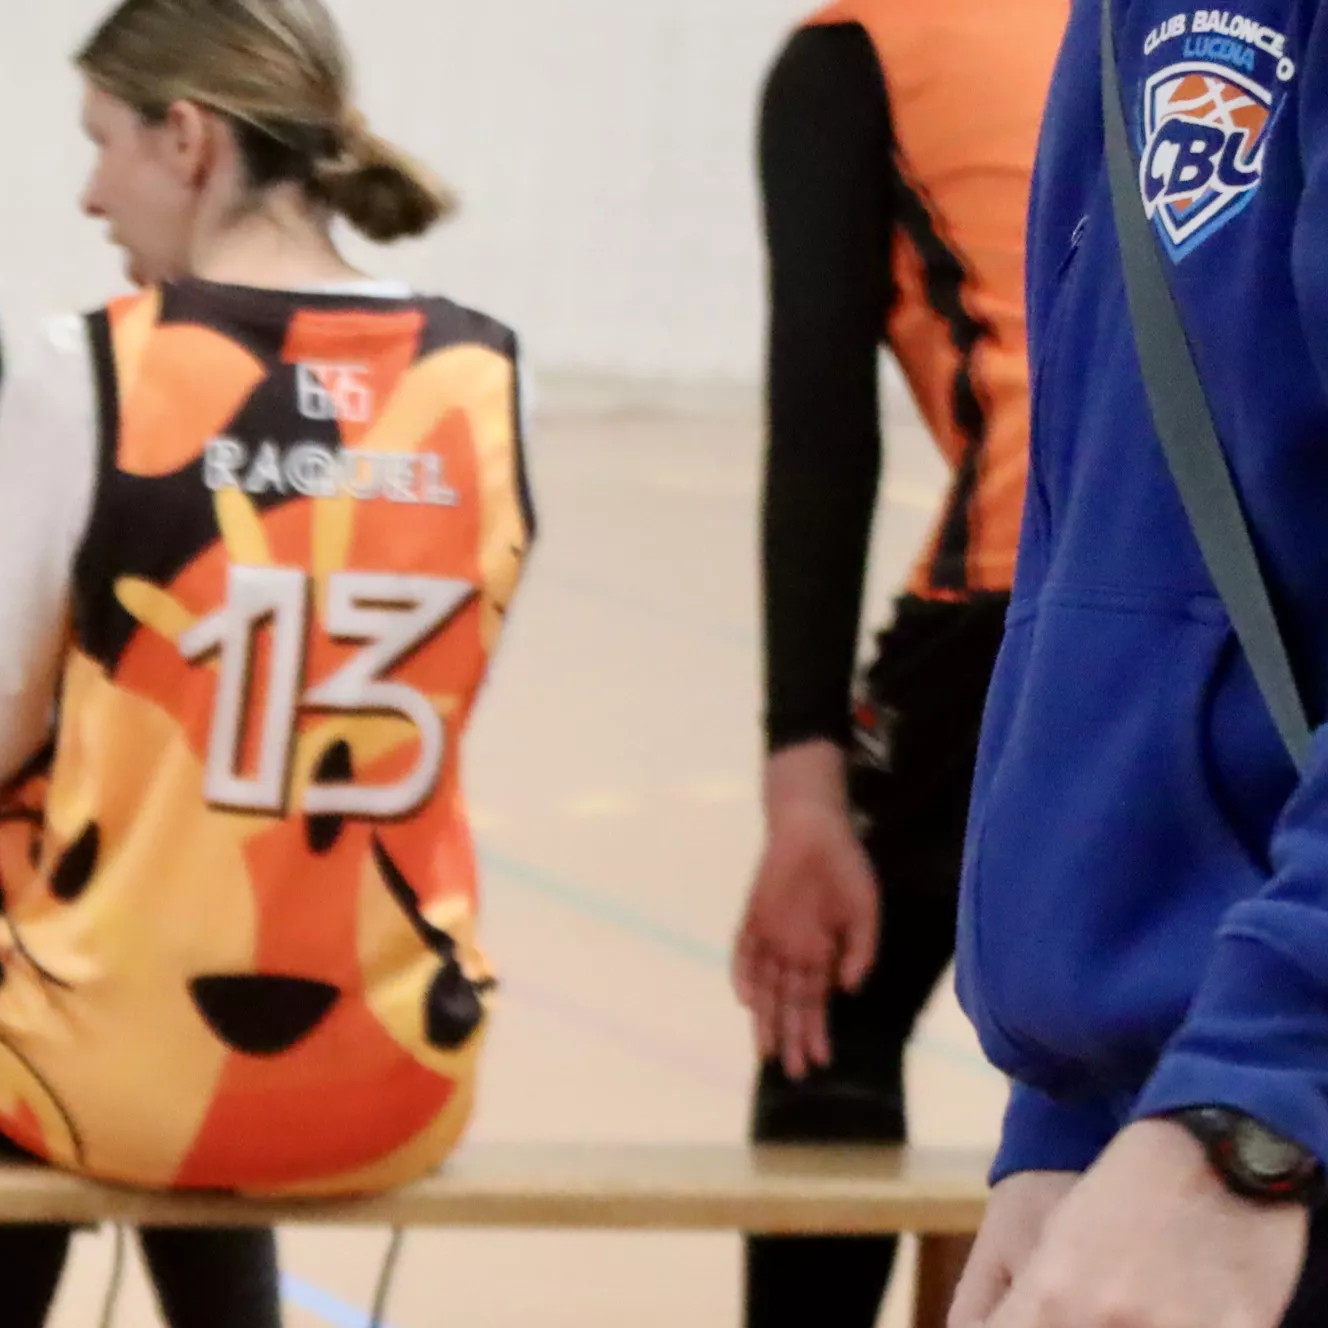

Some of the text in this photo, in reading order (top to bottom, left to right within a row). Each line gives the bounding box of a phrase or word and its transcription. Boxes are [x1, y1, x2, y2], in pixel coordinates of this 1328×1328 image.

[1144, 13, 1186, 56] CLUB
[1182, 37, 1256, 72] LUCENA
[203, 437, 461, 507] RAQUEL
[178, 563, 479, 822] 13
